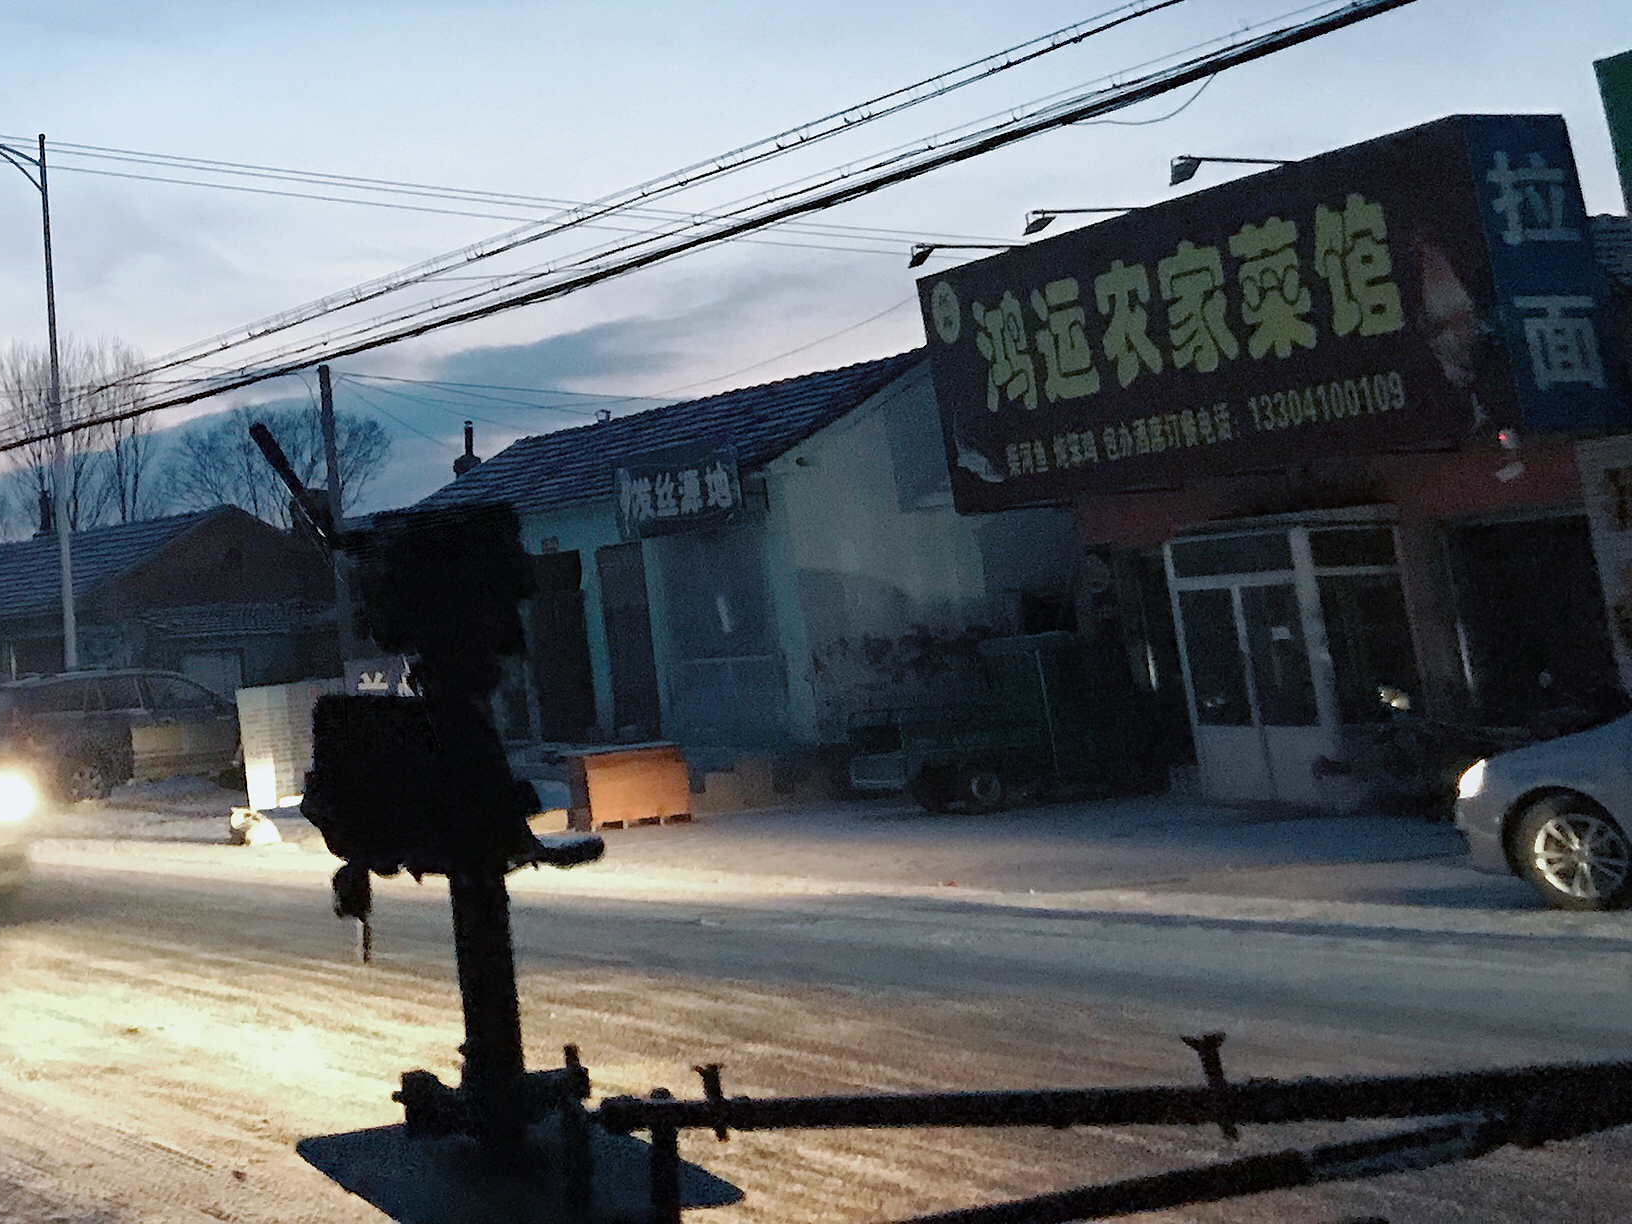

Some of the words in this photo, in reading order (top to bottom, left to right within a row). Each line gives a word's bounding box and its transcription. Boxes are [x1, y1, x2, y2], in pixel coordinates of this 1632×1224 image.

[972, 193, 1405, 413] 鸿运农家菜馆
[1487, 150, 1606, 391] 拉面
